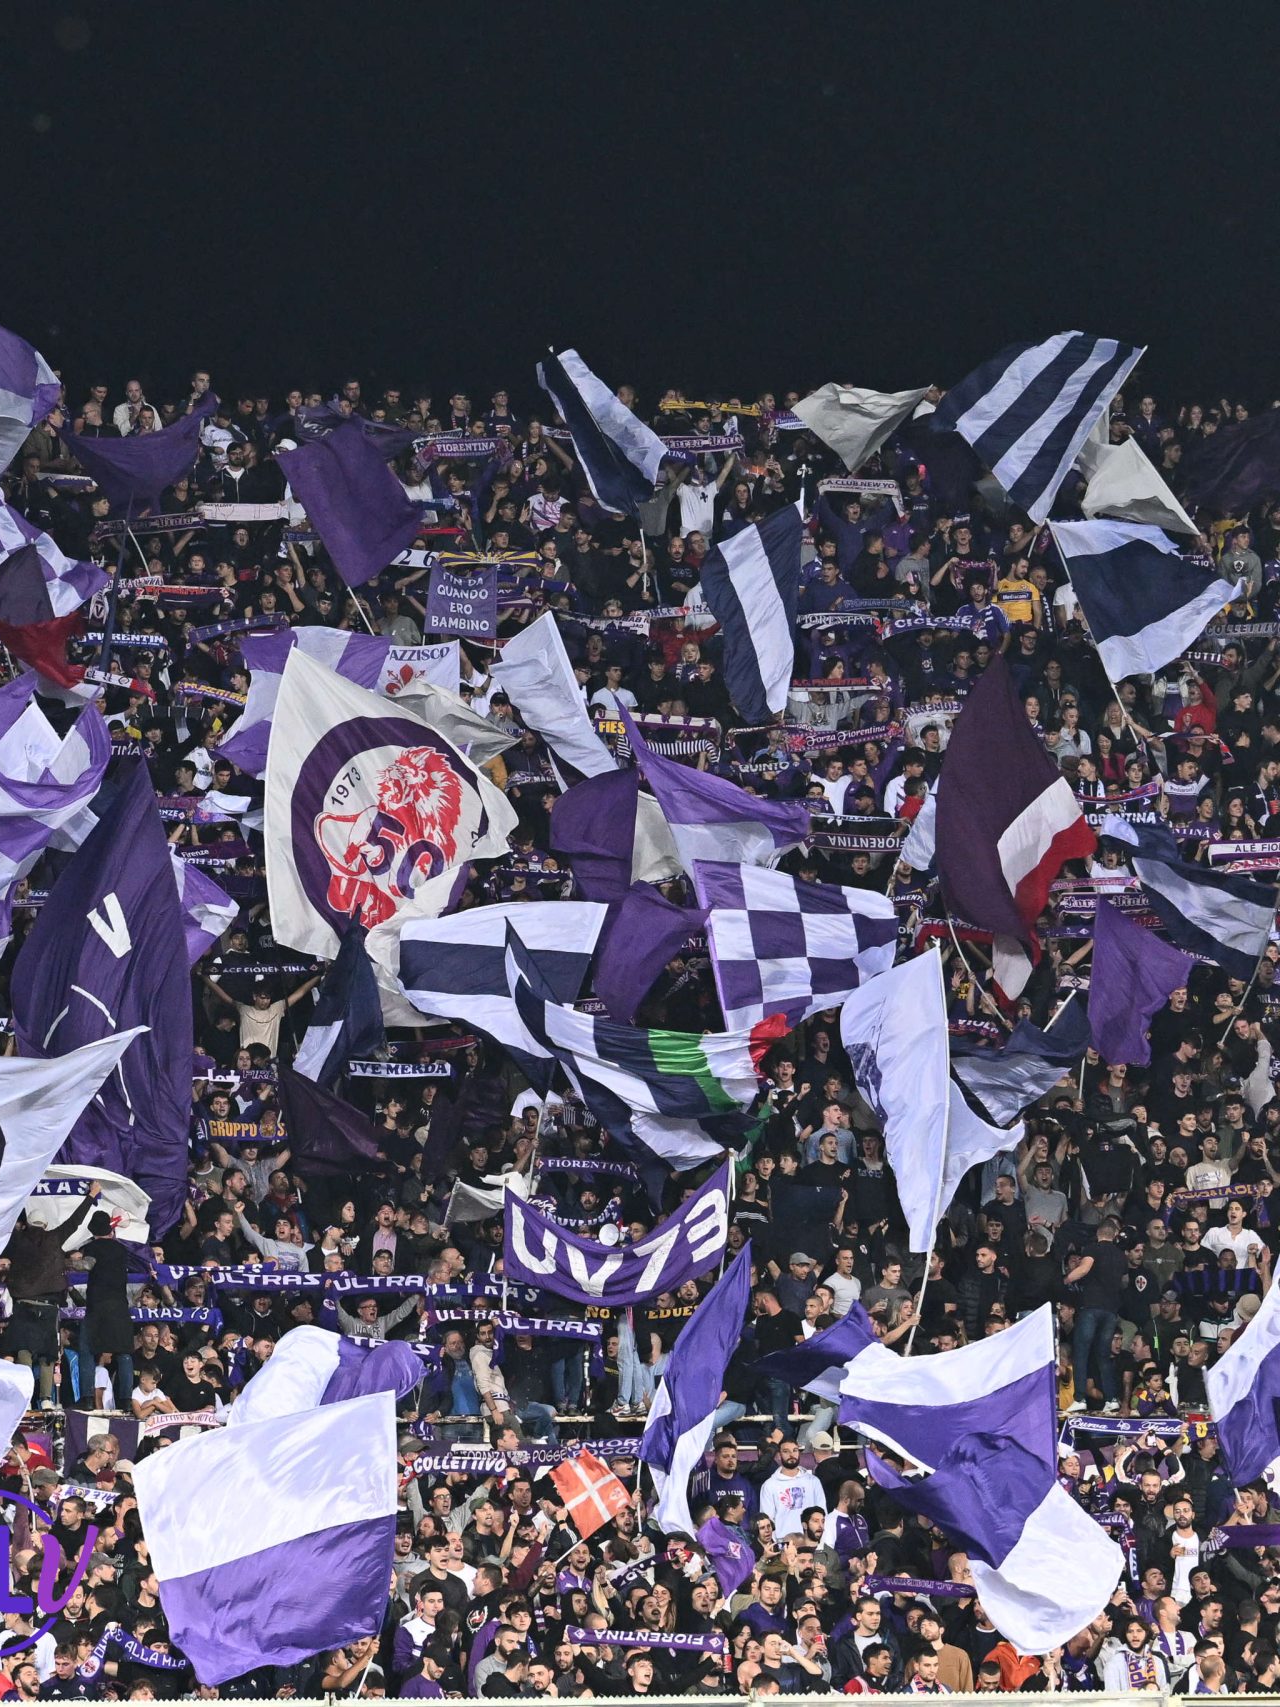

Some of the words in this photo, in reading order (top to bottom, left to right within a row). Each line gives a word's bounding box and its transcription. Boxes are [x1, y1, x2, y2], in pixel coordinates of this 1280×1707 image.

[436, 441, 496, 453] FIORENTINA
[668, 450, 687, 459] TINA
[861, 481, 878, 489] NEW
[468, 577, 483, 587] DA
[437, 584, 488, 600] QUANDO
[450, 601, 472, 615] ERO
[431, 616, 490, 631] BAMBINO
[894, 615, 972, 629] CICLONE
[87, 631, 164, 645] FIRENTIN
[389, 646, 451, 664] AZZISCO
[1187, 651, 1221, 663] TUTTI
[599, 720, 625, 734] FIES
[806, 732, 836, 747] Forza
[837, 725, 887, 742] Fiorentina
[739, 760, 789, 773] QUINTO
[331, 766, 361, 806] 1973
[181, 850, 210, 859] Firenze
[386, 1062, 449, 1076] MERDA
[209, 1119, 258, 1138] GRUPPO
[548, 1159, 631, 1176] FIORENTINA
[36, 1181, 90, 1194] RAS
[511, 1188, 729, 1297] UV73
[211, 1273, 321, 1287] ULTRAS
[333, 1274, 424, 1292] ULTRA
[190, 1306, 209, 1320] 73
[647, 1303, 699, 1319] EDUE
[499, 1316, 601, 1337] ULTRAS
[1068, 1417, 1108, 1430] Curva
[413, 1456, 508, 1474] COLLETTIVO
[594, 1628, 705, 1647] FIORENTINA
[123, 1640, 159, 1666] ALLA
[162, 1654, 187, 1671] MIA
